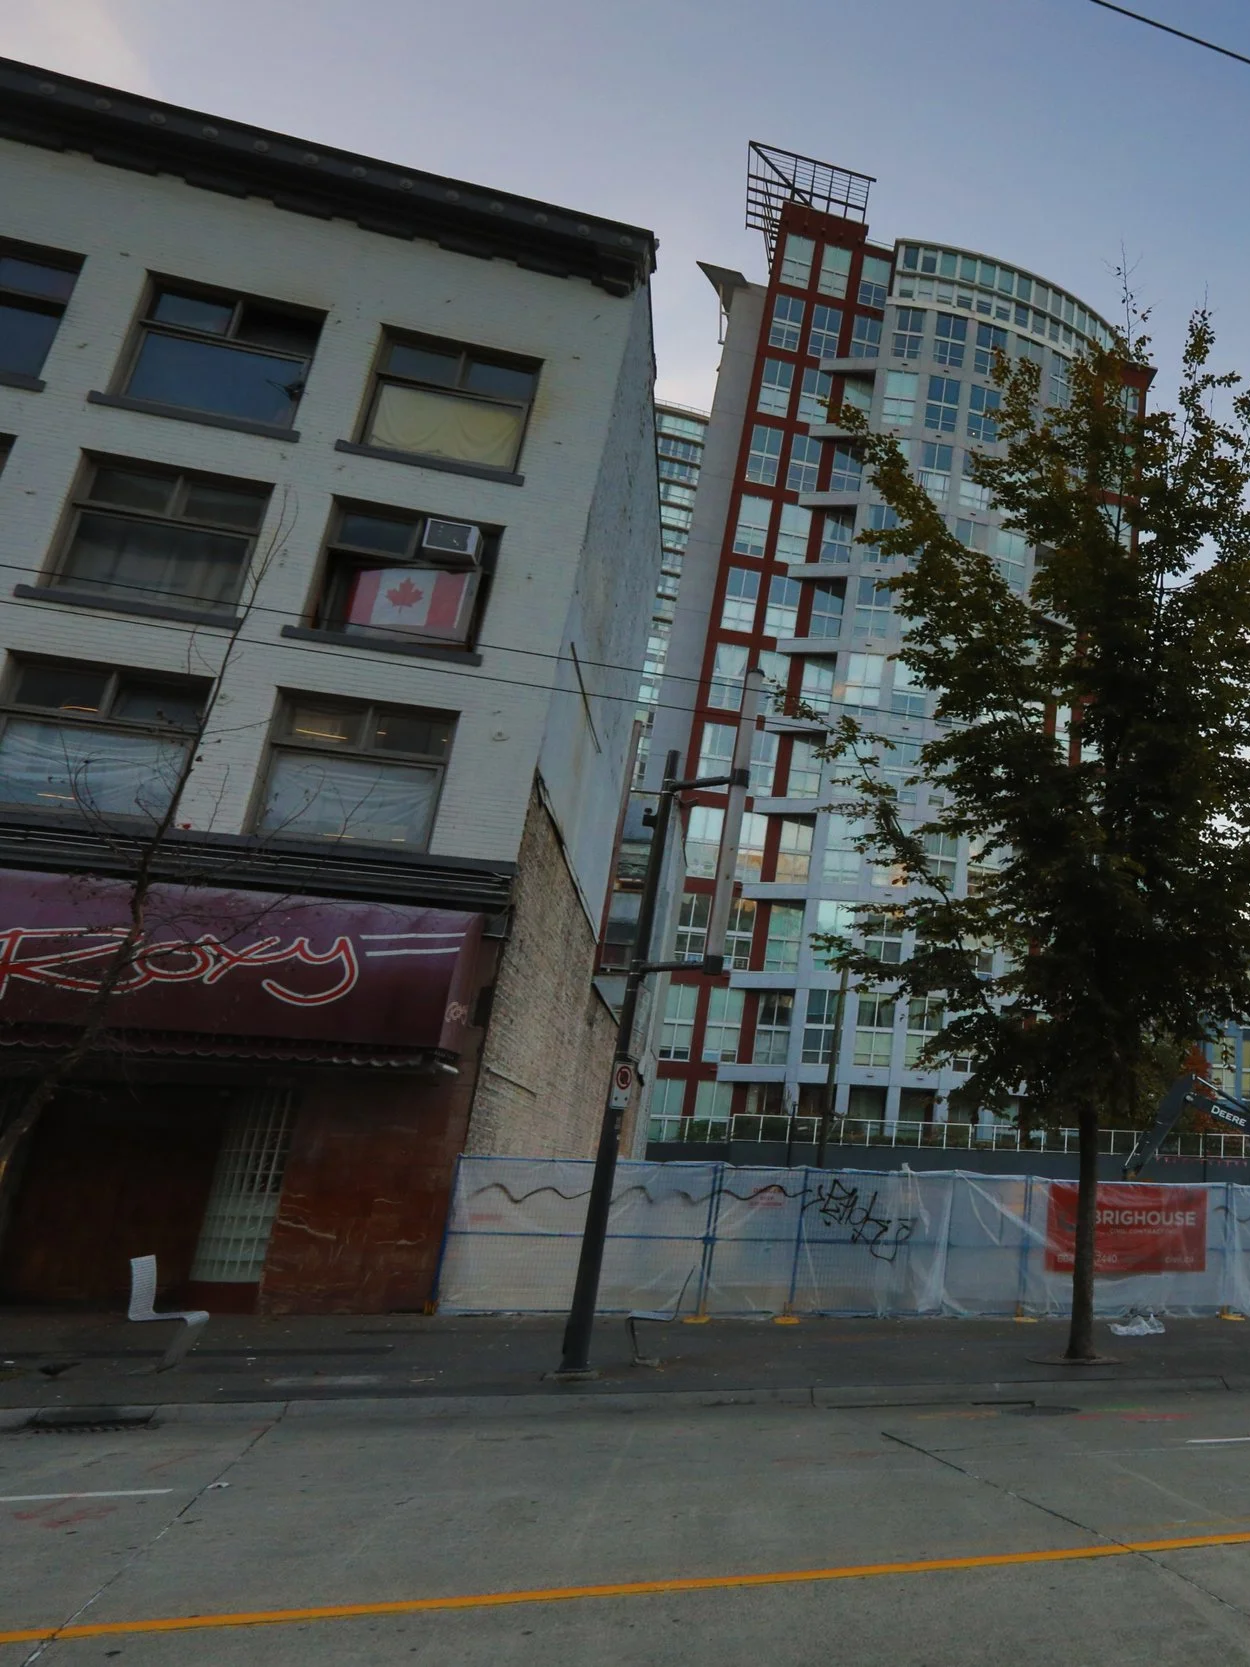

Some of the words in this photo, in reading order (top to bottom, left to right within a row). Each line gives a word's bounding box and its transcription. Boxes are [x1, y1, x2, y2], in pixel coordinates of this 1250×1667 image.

[0, 927, 359, 1006] Roxy
[1210, 1104, 1247, 1127] DEERE
[1095, 1209, 1197, 1227] BRIGHOUSE
